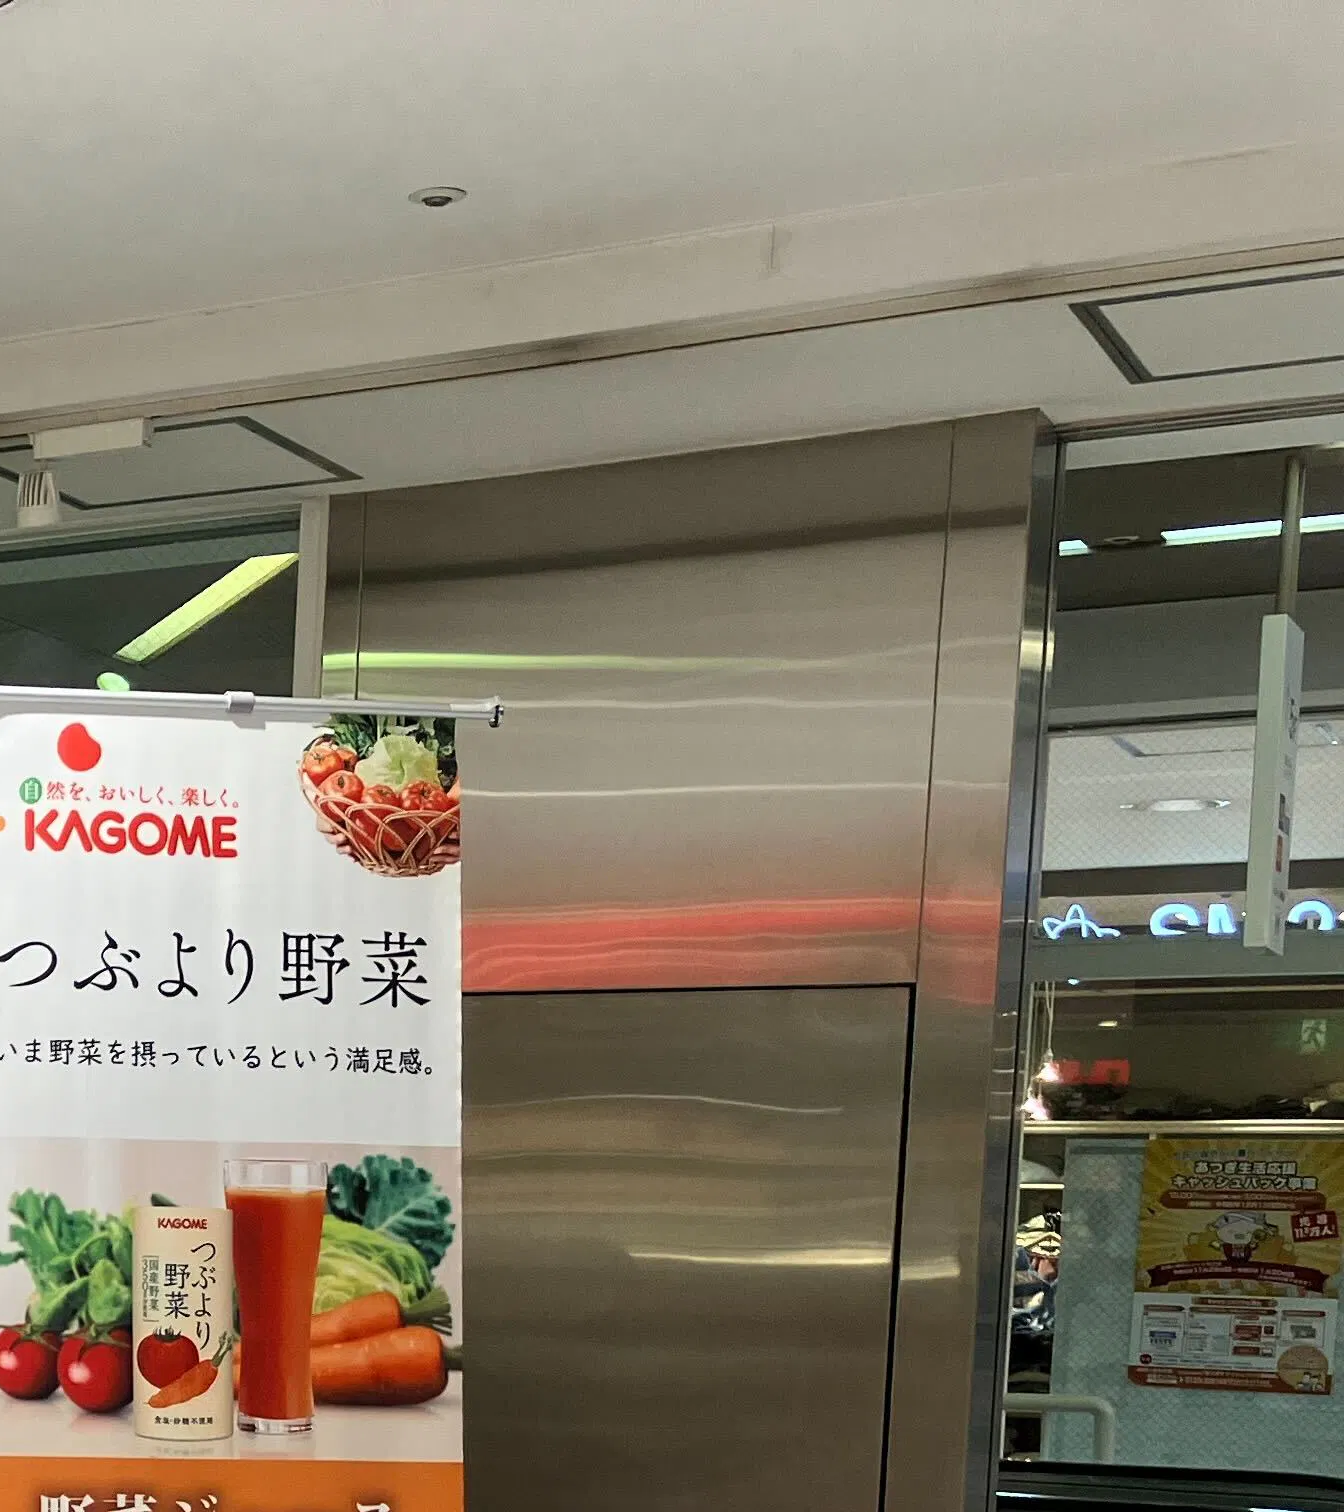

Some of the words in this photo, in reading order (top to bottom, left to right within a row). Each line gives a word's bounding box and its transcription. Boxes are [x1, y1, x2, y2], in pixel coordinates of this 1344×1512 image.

[20, 777, 241, 809] 自然を、おいしく、楽しく。
[23, 809, 238, 859] KAGOME
[157, 1217, 208, 1230] KAGOME
[163, 1263, 190, 1319] 野菜
[190, 1242, 216, 1351] つぶより
